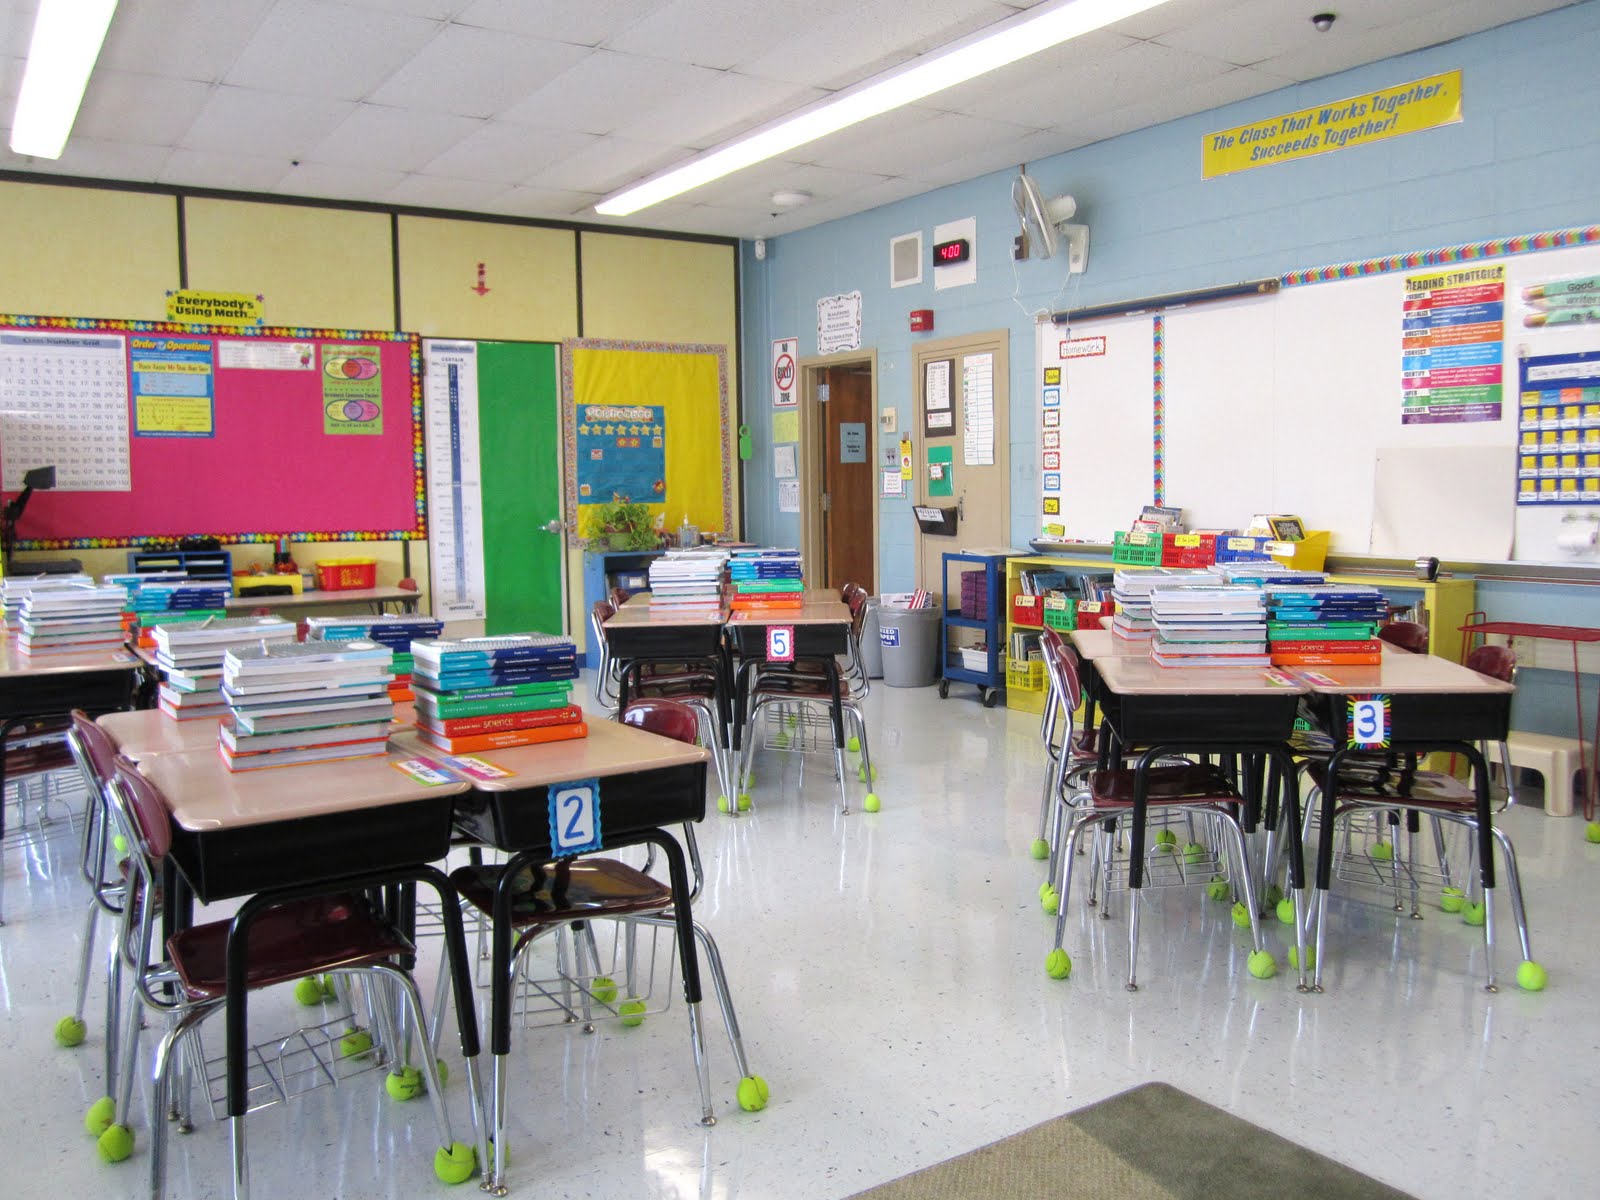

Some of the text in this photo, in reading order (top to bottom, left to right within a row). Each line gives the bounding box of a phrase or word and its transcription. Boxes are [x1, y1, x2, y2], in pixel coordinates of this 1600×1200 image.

[1213, 136, 1235, 152] The
[1239, 125, 1278, 145] Class
[1280, 115, 1313, 135] That
[1317, 103, 1367, 126] Works
[1250, 112, 1399, 161] Succeeds Together!
[1406, 267, 1503, 290] READING STRATEGIES
[1567, 280, 1594, 292] Good
[176, 296, 254, 309] Everybody's
[175, 306, 212, 318] Using
[132, 339, 156, 349] Order
[166, 340, 211, 352] Operations
[781, 343, 788, 352] NO
[1063, 341, 1102, 355] Homework
[780, 392, 791, 402] ZONE
[773, 632, 786, 655] 5
[483, 717, 514, 729] science
[1358, 704, 1377, 738] 3
[563, 795, 585, 840] 2
